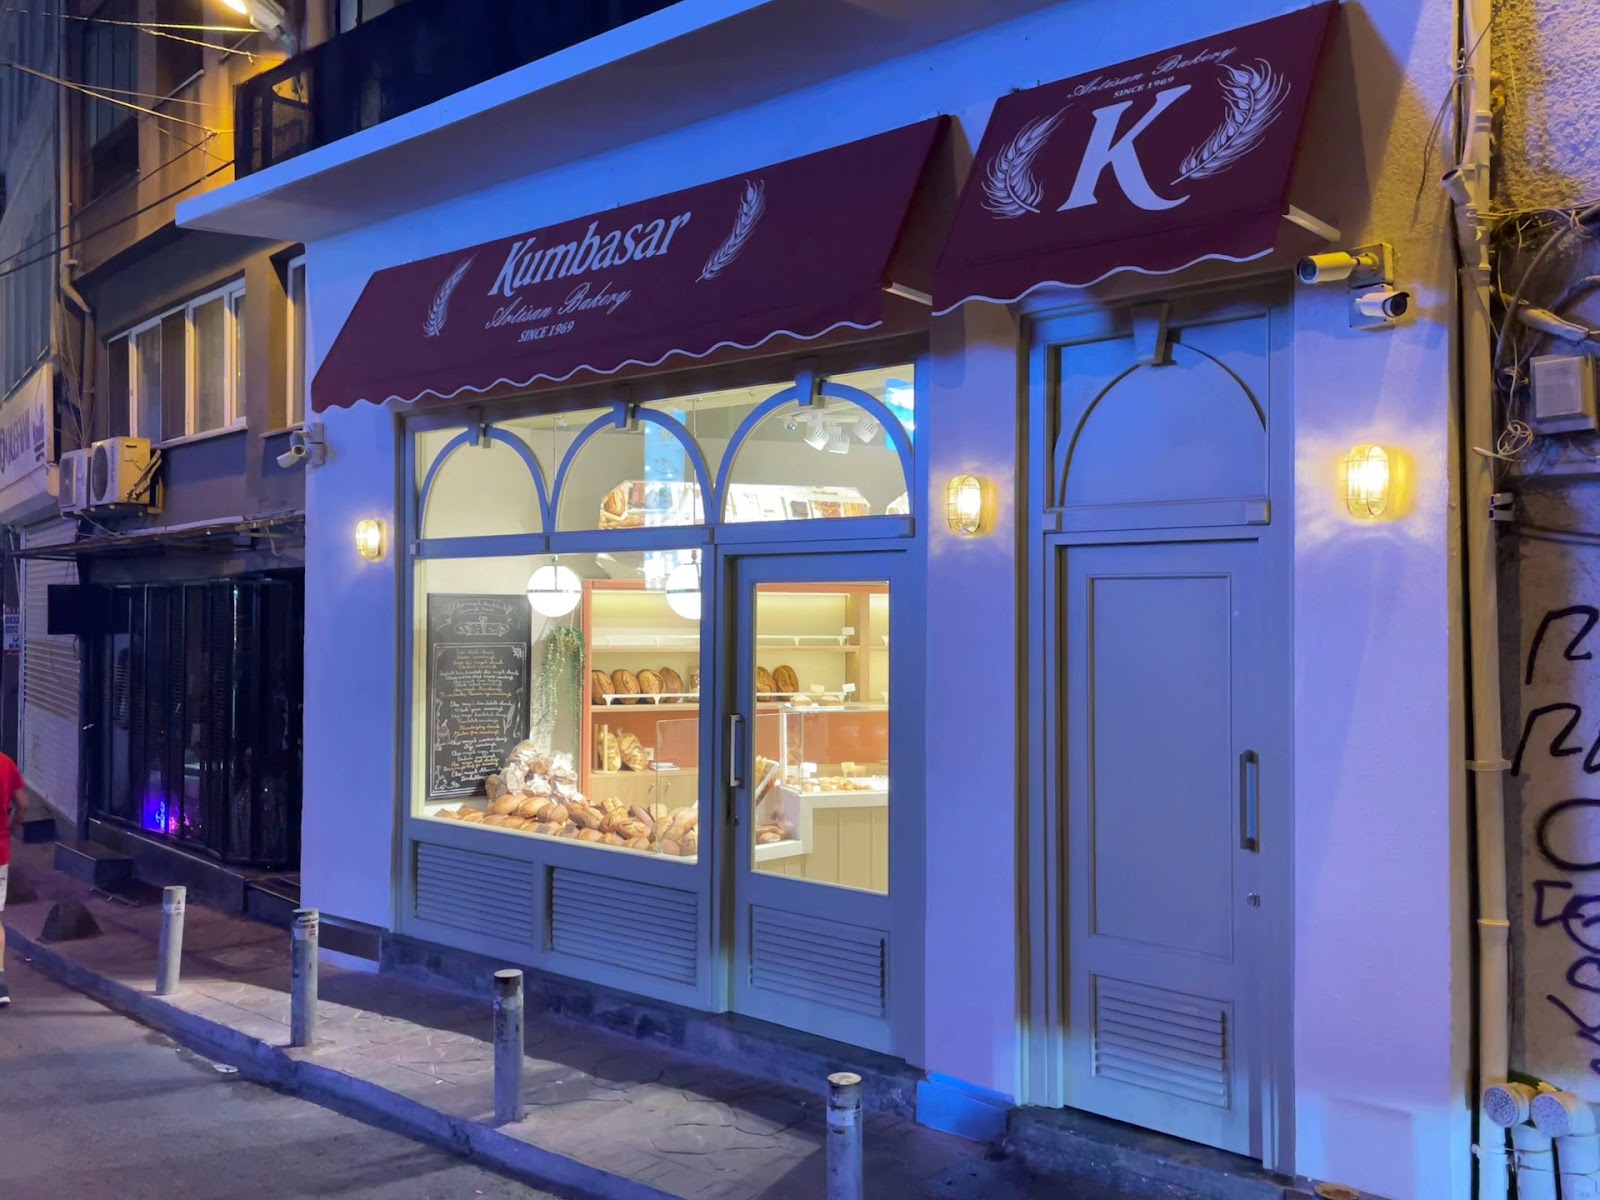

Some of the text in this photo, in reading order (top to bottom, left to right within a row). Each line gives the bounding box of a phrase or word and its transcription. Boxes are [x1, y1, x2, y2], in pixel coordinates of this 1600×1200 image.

[1068, 47, 1237, 98] Artisan Bakery
[1113, 76, 1175, 98] SINCE 1969
[1056, 84, 1192, 211] K
[487, 211, 691, 297] Kumbasar
[485, 282, 632, 329] Artisan Bakery
[518, 320, 575, 343] SINCE 1969
